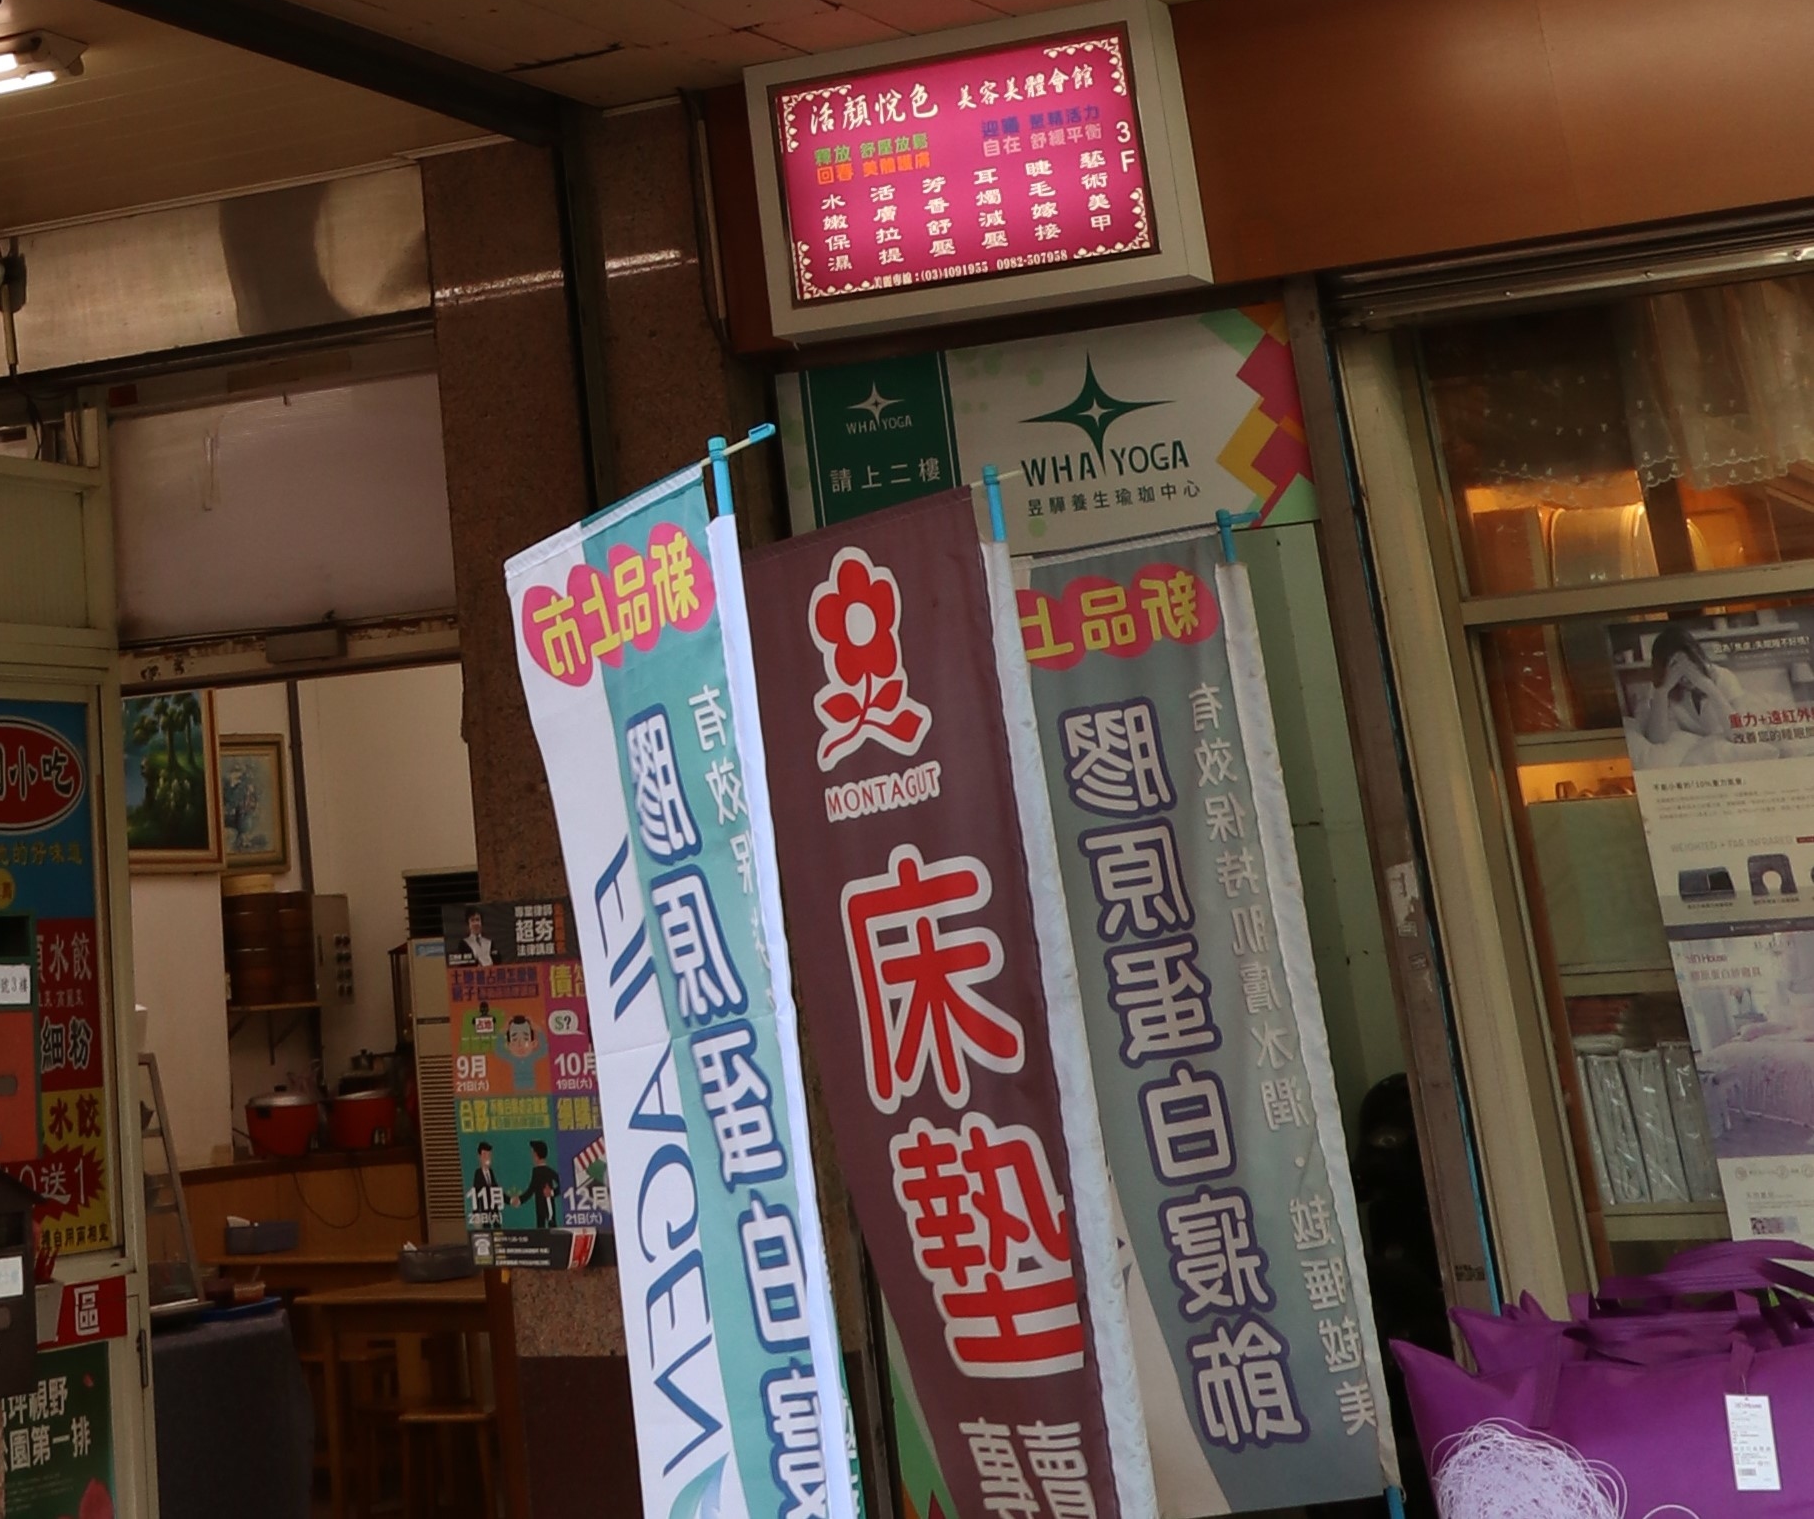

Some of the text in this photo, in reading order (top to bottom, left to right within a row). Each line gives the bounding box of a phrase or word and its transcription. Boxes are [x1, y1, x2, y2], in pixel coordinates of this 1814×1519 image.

[956, 63, 1095, 111] 美容美體會館
[983, 135, 1022, 158] 自在
[846, 415, 913, 435] WHA YOGA
[829, 457, 942, 494] 請上二樓
[1020, 439, 1191, 487] WHA YOGA
[1027, 478, 1202, 518] 昱驊養生瑜珈中心
[827, 764, 939, 819] MONTAGUT
[515, 918, 555, 944] 超夯
[456, 1054, 487, 1079] 9月
[48, 1093, 102, 1143] 水餃
[846, 854, 1084, 1367] 床墊
[466, 1186, 506, 1212] 11月
[563, 1185, 610, 1212] 12月
[3, 1415, 92, 1473] 園第一排
